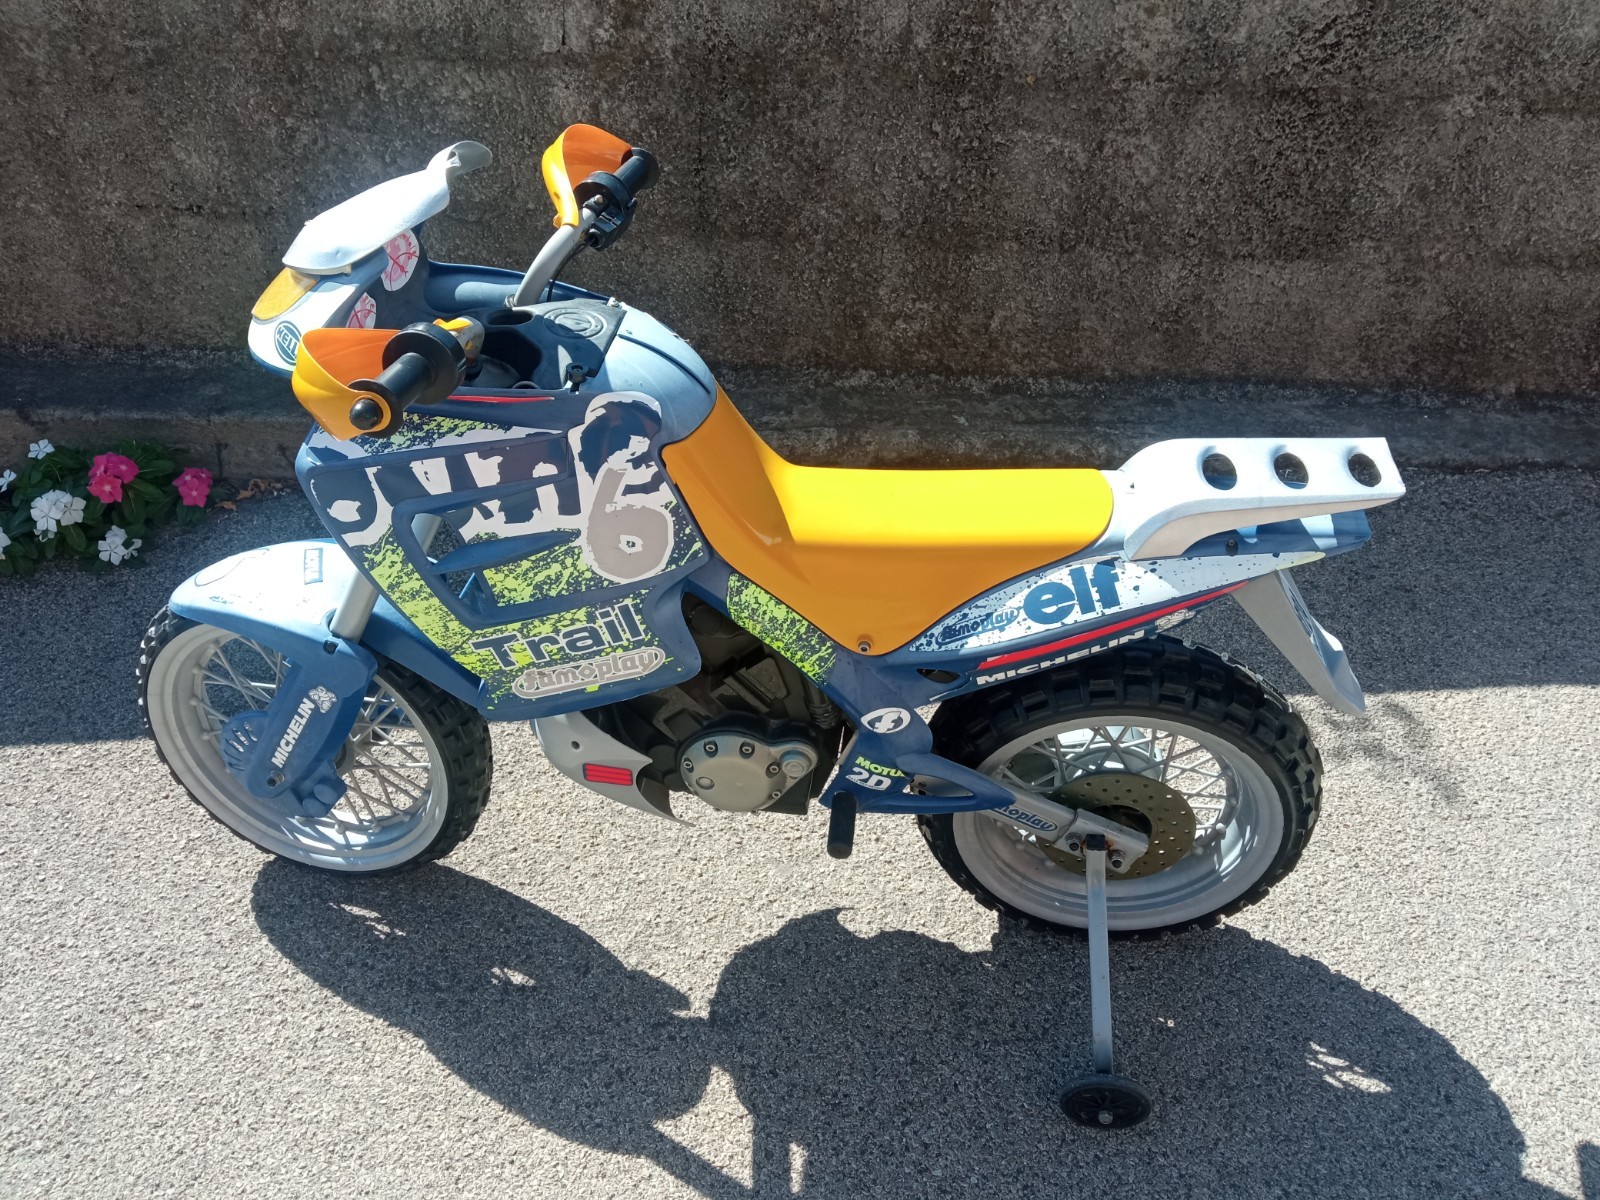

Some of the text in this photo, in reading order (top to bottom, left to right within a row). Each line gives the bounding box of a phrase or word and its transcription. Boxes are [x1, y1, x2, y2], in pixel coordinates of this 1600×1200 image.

[277, 325, 299, 362] HELL
[1024, 559, 1120, 625] elf
[471, 602, 646, 670] Trail
[976, 629, 1145, 685] MICHELIN
[521, 648, 658, 692] famoplay
[271, 697, 315, 769] MICHELIN
[846, 766, 892, 791] 2D
[855, 756, 906, 777] MOTU
[1000, 806, 1054, 832] oplay
